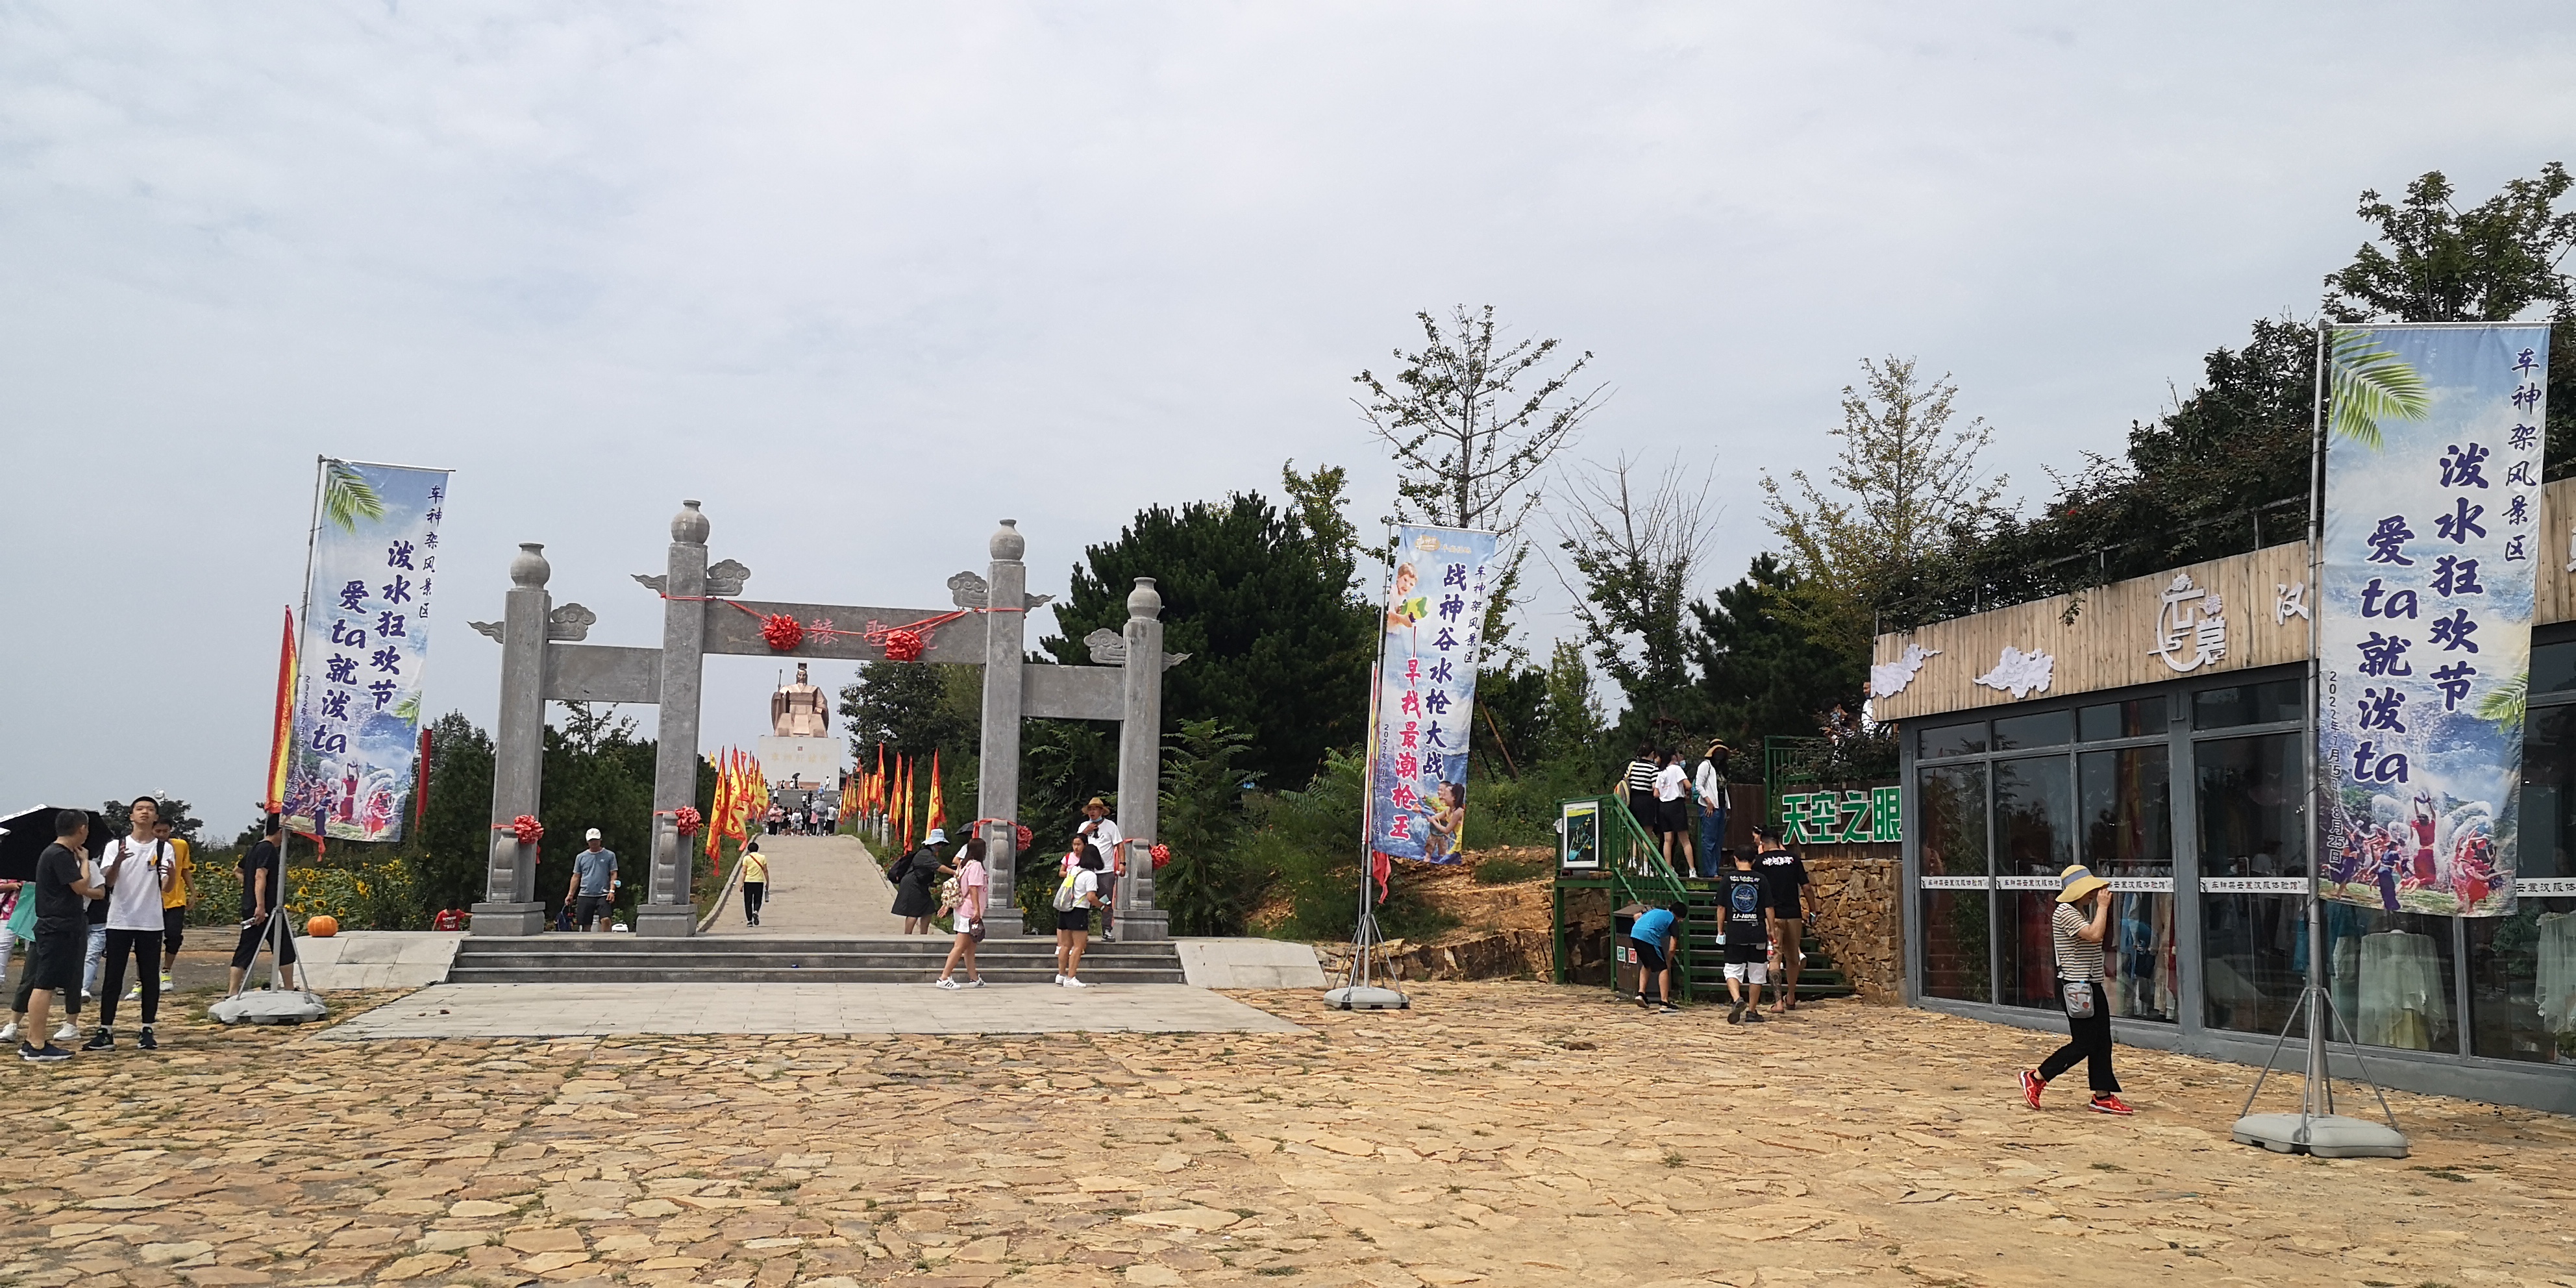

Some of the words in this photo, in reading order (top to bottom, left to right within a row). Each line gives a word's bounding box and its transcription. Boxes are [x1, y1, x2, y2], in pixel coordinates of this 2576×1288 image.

[2503, 346, 2543, 562] 车神架风景区
[367, 539, 415, 712] 泼水狂欢节
[419, 484, 444, 619] 车神架风景区
[1463, 565, 1487, 664] 车神架风景区
[2427, 442, 2490, 712] 泼水狂欢节
[310, 579, 368, 754] 爱ta就泼ta
[1421, 562, 1468, 780] 战神谷水枪大战
[2351, 514, 2420, 784] 爱ta就泼ta
[1782, 786, 1902, 845] 天空之眼
